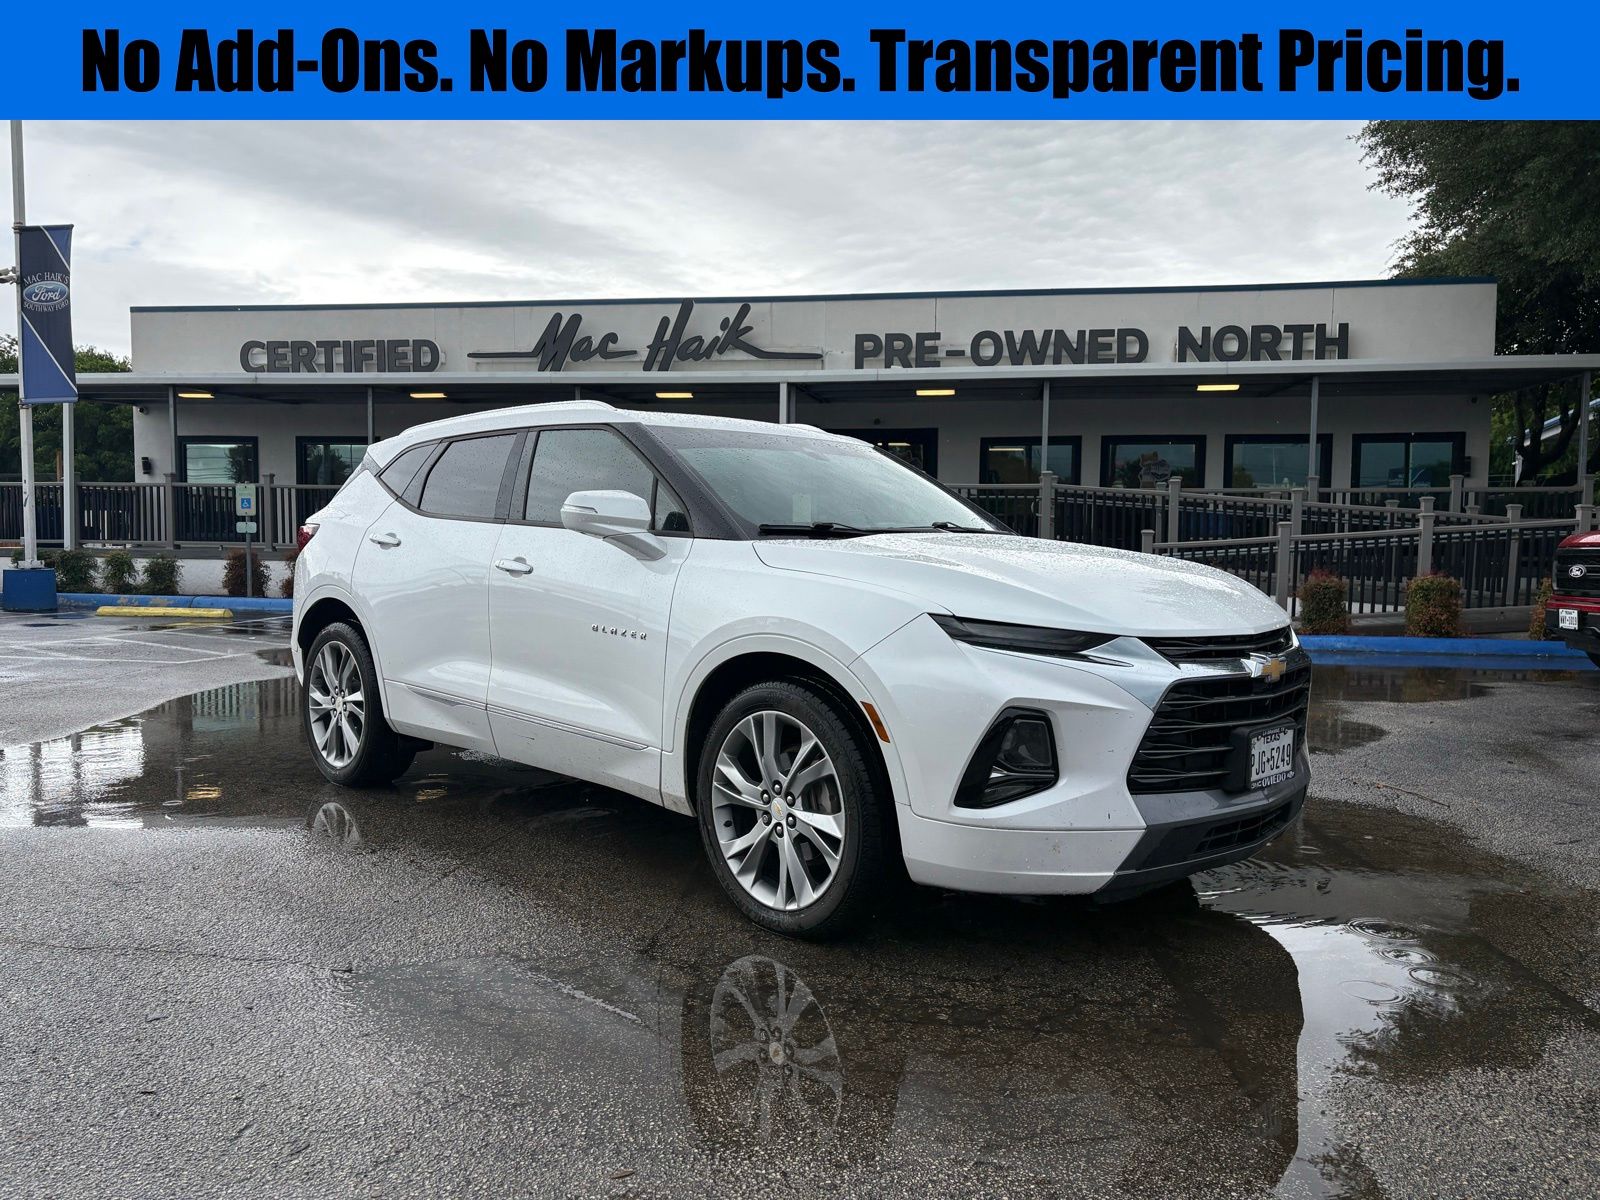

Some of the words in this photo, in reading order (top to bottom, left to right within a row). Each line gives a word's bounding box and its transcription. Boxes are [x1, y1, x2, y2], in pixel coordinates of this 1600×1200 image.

[24, 273, 42, 286] MAC
[44, 272, 69, 285] HAIK'S
[32, 285, 60, 301] Ford
[240, 339, 440, 373] CERTIFIED
[467, 312, 637, 372] Mac
[642, 299, 823, 372] Haik
[854, 328, 1149, 370] PRE-OWNED
[1177, 322, 1350, 363] NORTH
[591, 623, 647, 641] BLAZER
[1263, 733, 1280, 744] TEXAS
